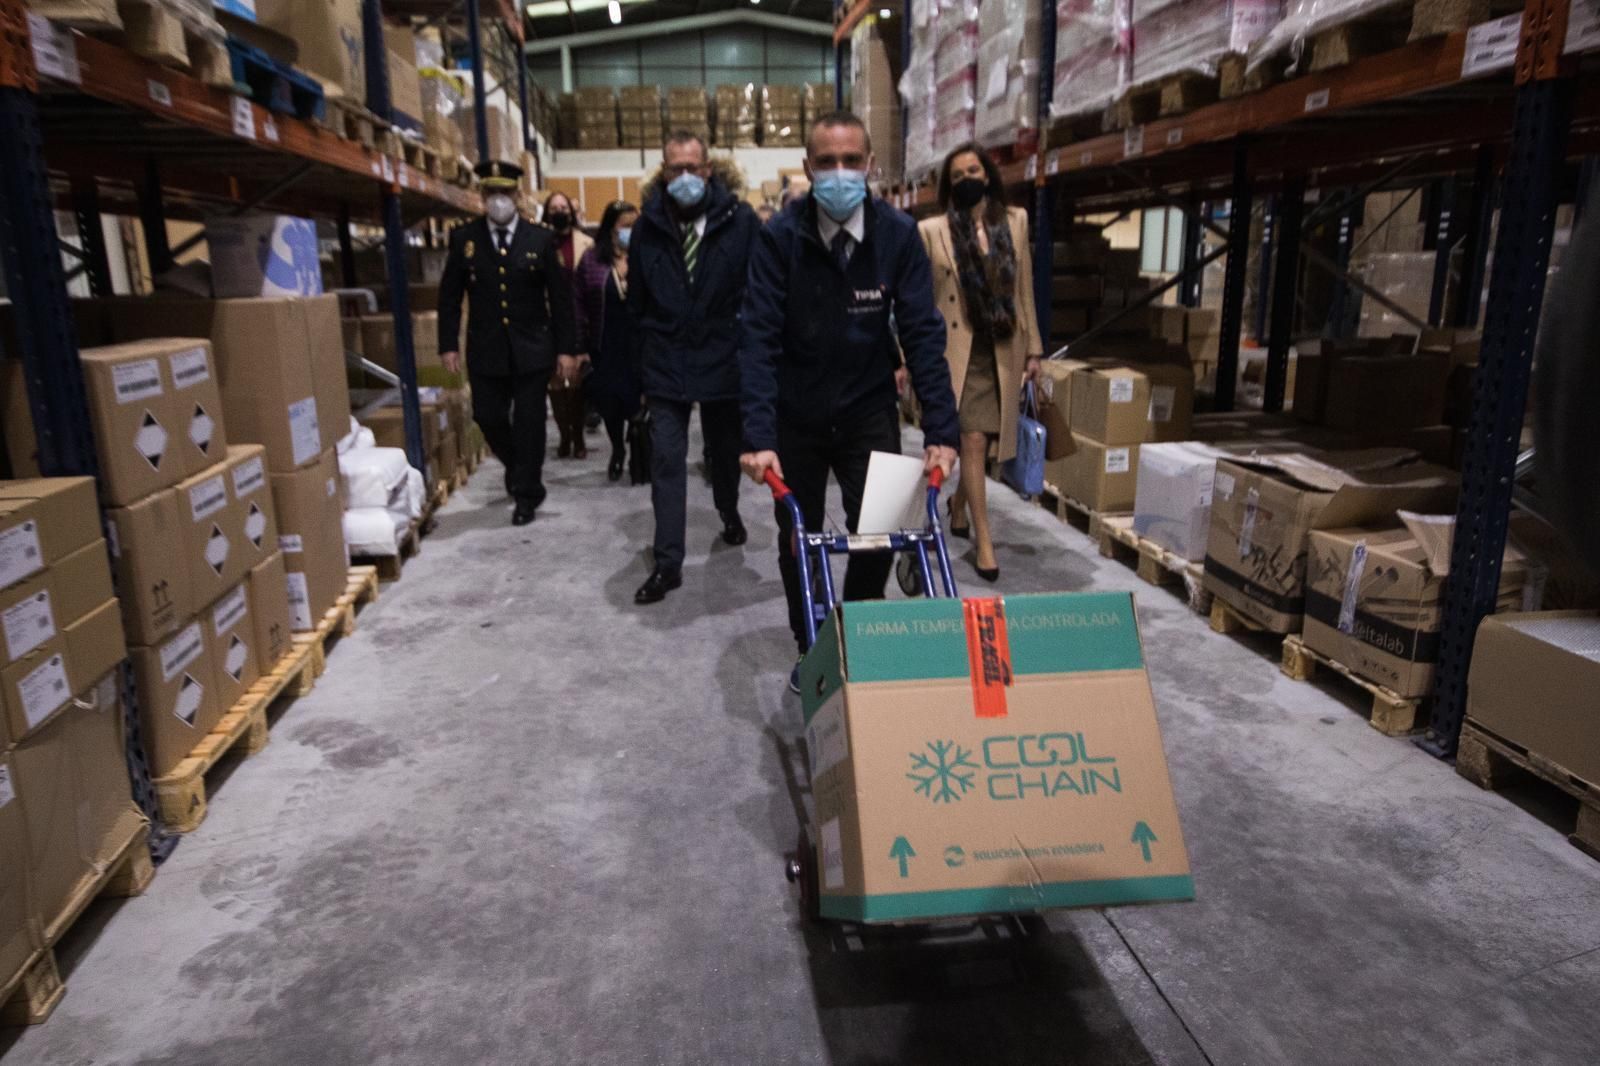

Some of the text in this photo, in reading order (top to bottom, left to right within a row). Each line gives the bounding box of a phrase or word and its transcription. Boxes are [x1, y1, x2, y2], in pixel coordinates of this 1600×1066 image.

[856, 621, 909, 636] FARMA
[1022, 611, 1120, 630] CONTROLADA
[982, 731, 1116, 769] COOL
[987, 767, 1122, 801] CHAIN
